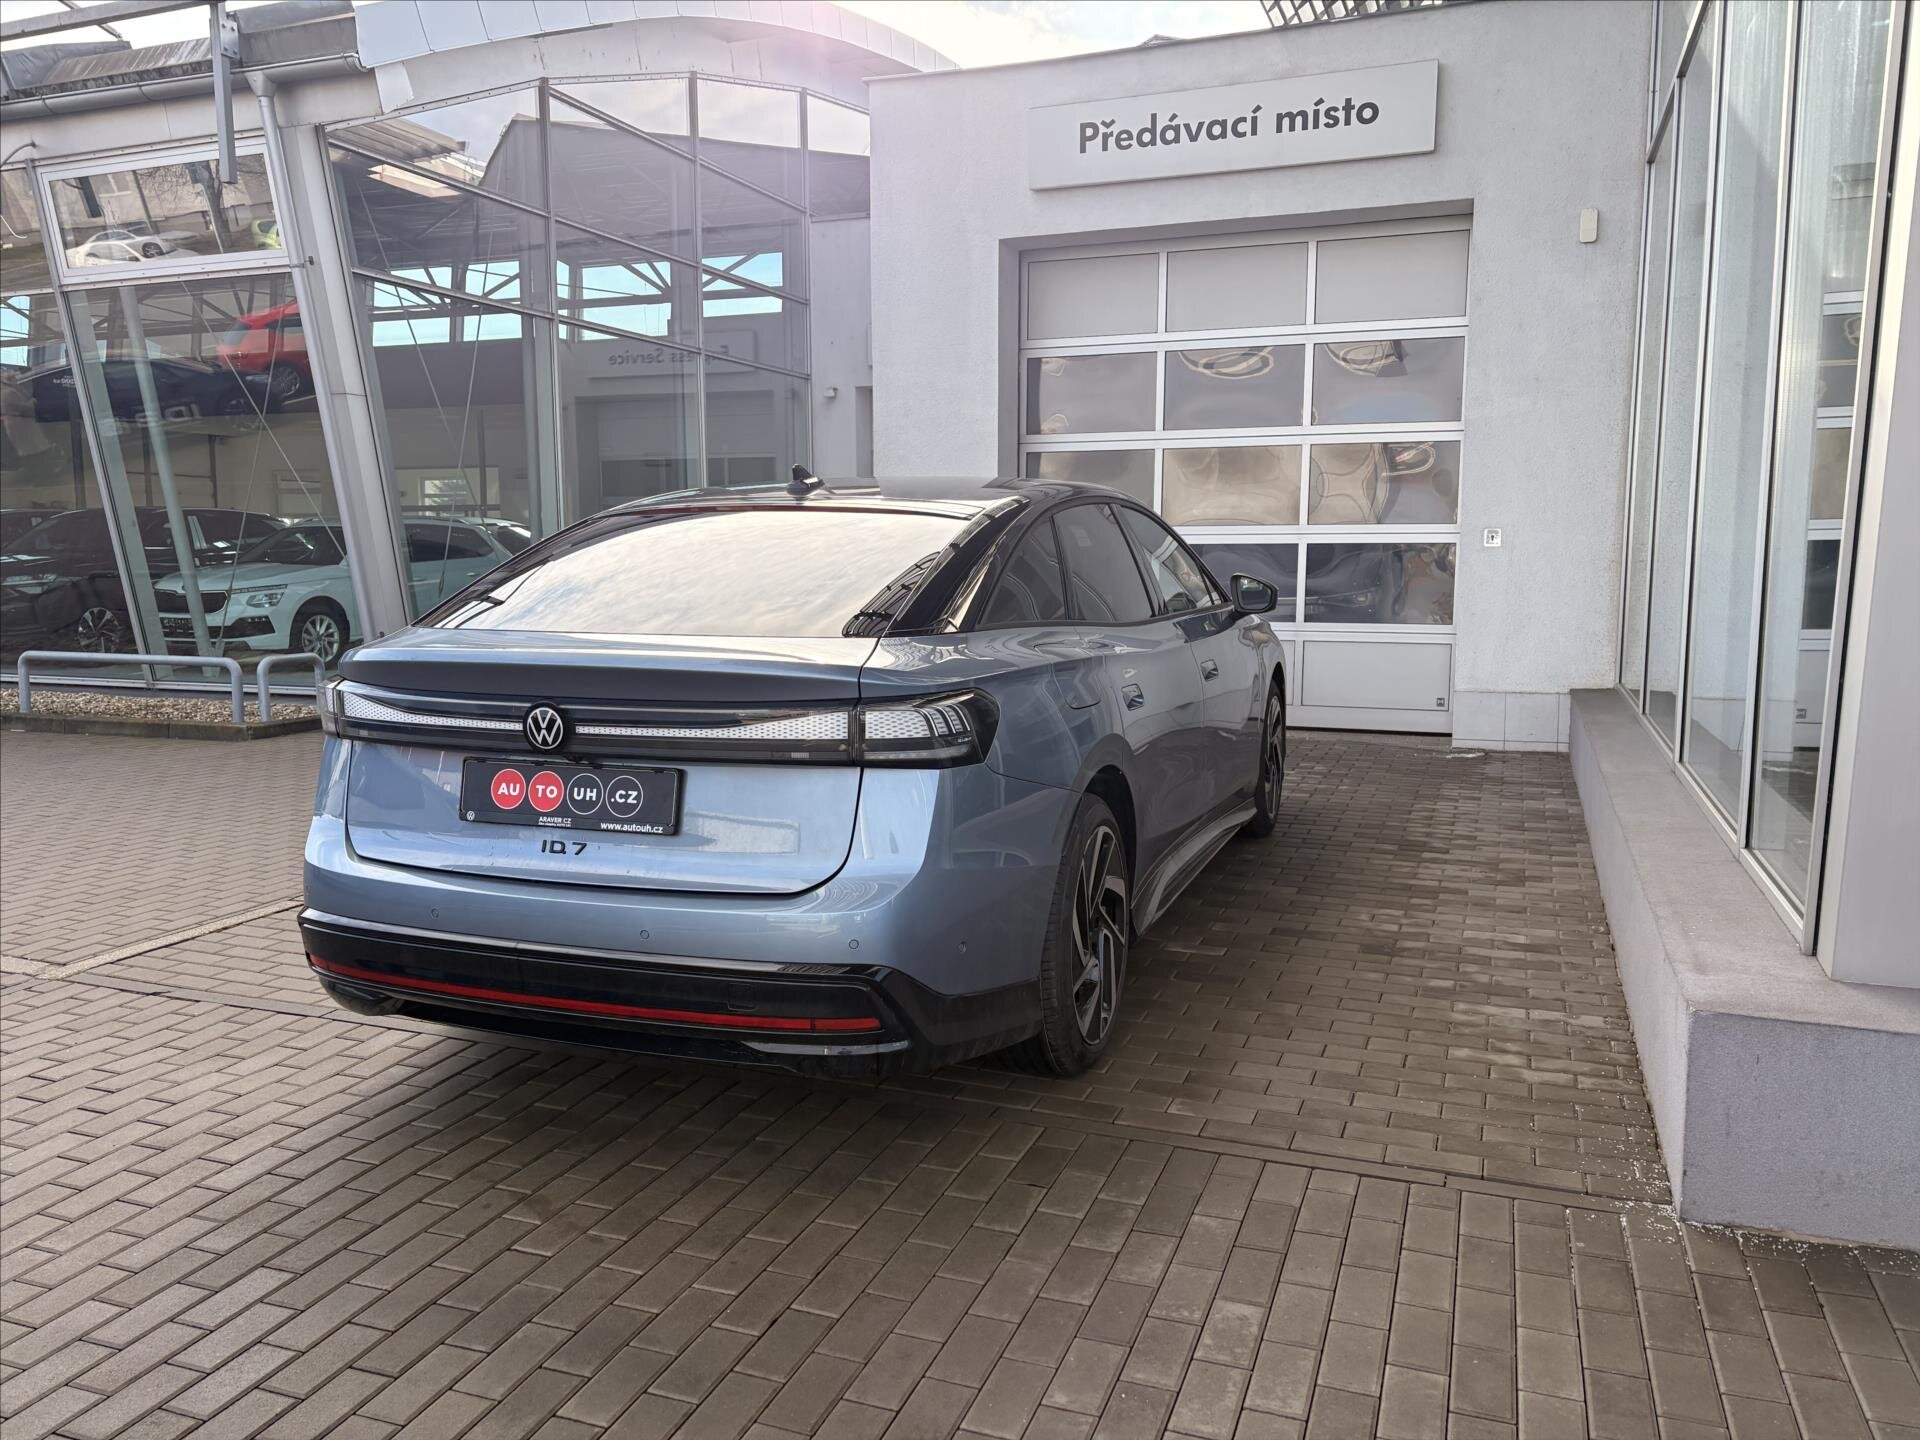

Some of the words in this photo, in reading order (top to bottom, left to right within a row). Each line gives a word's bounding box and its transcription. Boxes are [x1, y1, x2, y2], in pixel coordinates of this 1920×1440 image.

[1079, 103, 1263, 154] Předávací
[1275, 96, 1380, 134] místo
[600, 822, 664, 834] www.autouh.cz
